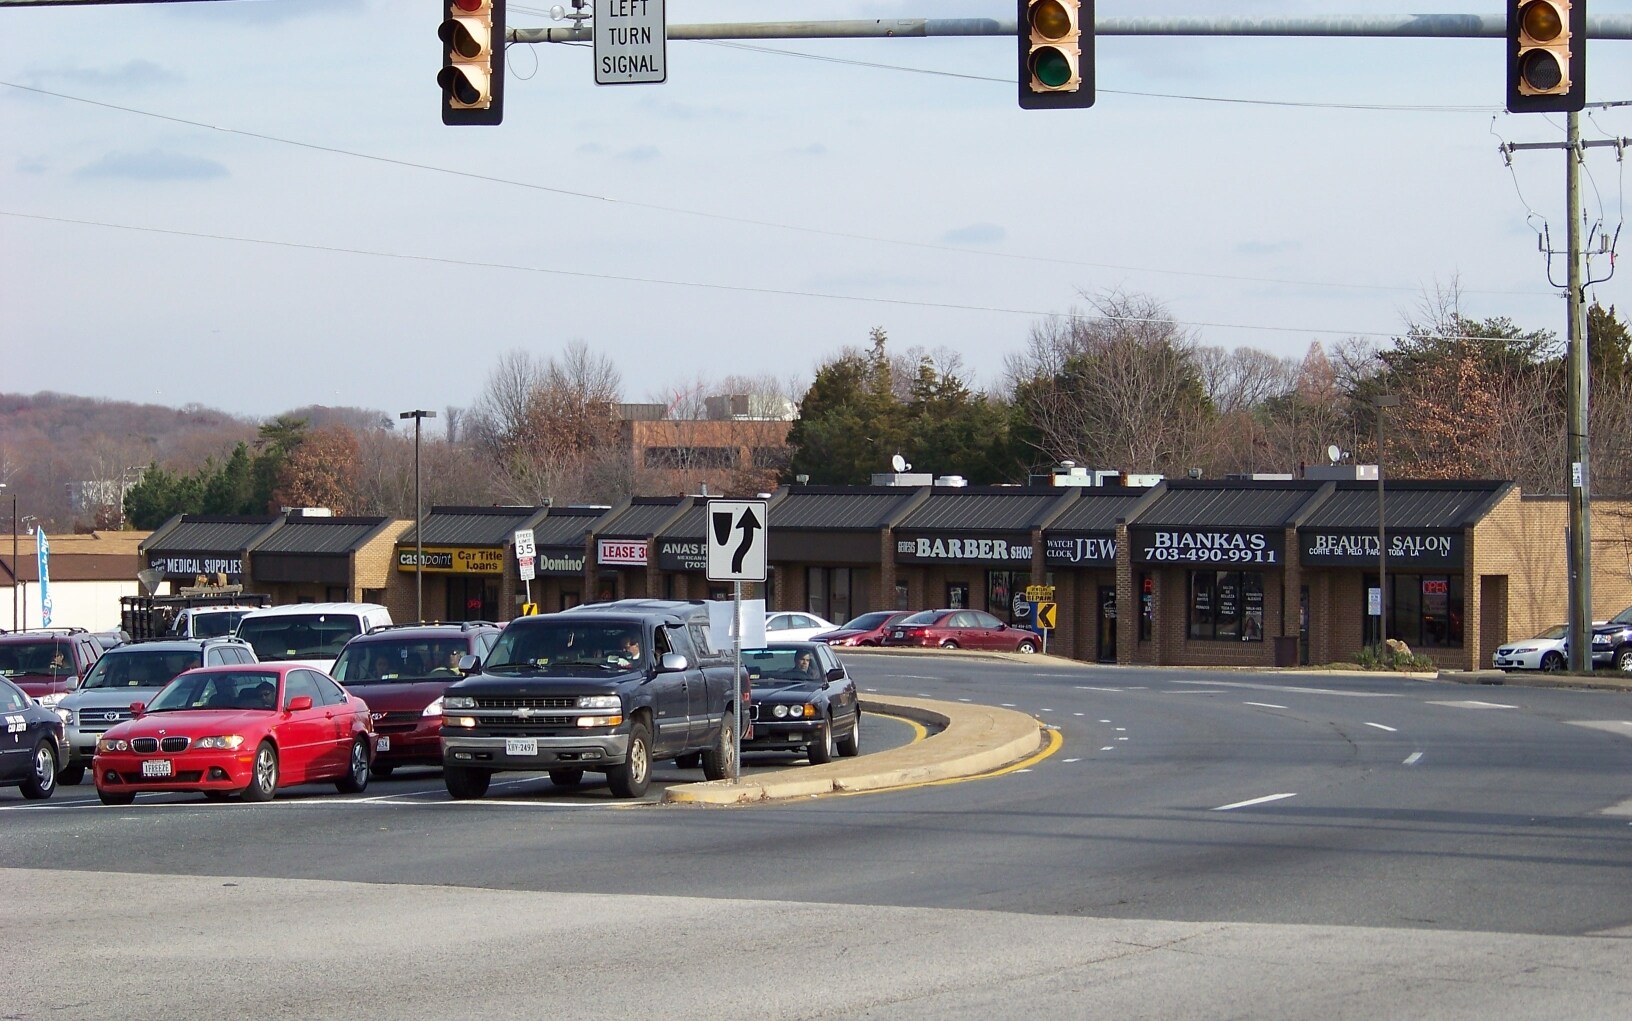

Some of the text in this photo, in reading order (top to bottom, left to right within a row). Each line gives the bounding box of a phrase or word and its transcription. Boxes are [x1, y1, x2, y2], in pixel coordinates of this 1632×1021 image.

[610, 0, 649, 17] LEFT
[609, 26, 651, 45] TURN
[602, 54, 659, 74] SIGNAL
[1047, 540, 1074, 548] WATCH
[1154, 532, 1266, 549] BIANKA'S
[1392, 536, 1452, 551] SALON
[518, 544, 533, 555] 35
[603, 546, 635, 558] LEASE
[662, 543, 699, 555] ANA'S
[915, 538, 1009, 559] BARBER
[1010, 546, 1033, 559] SHOP
[1046, 550, 1073, 558] CLOCK
[1144, 548, 1277, 562] 703-490-9911
[1347, 548, 1362, 556] PELO
[1388, 548, 1404, 556] TODA
[1410, 548, 1419, 556] LA
[400, 553, 452, 566] cashpoint
[458, 551, 503, 561] Car Title
[540, 554, 586, 571] Domino'
[167, 559, 242, 574] MEDICAL SUPPLIES
[466, 561, 498, 570] Loans
